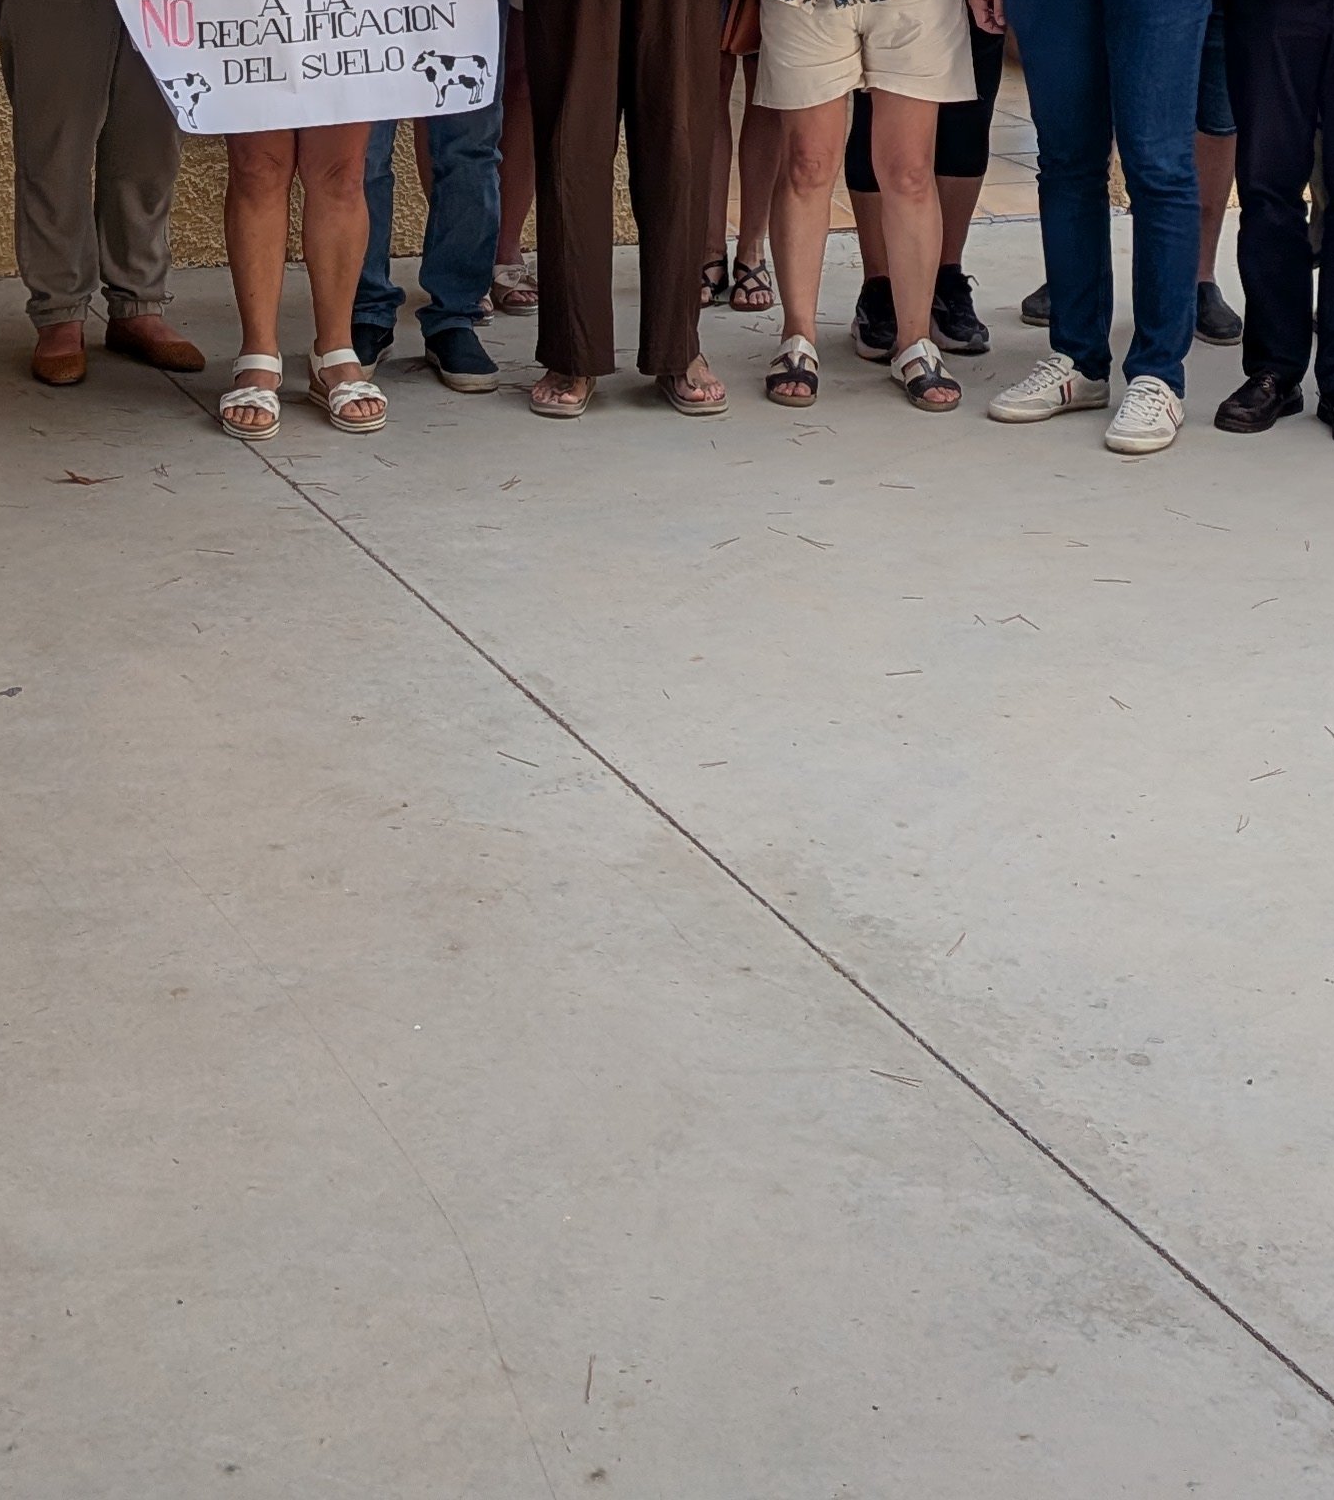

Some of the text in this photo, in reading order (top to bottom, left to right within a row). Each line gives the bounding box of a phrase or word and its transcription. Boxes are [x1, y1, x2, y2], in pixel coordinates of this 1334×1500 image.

[198, 2, 457, 49] RECALIFICACION
[223, 47, 404, 85] DEL SUELO
